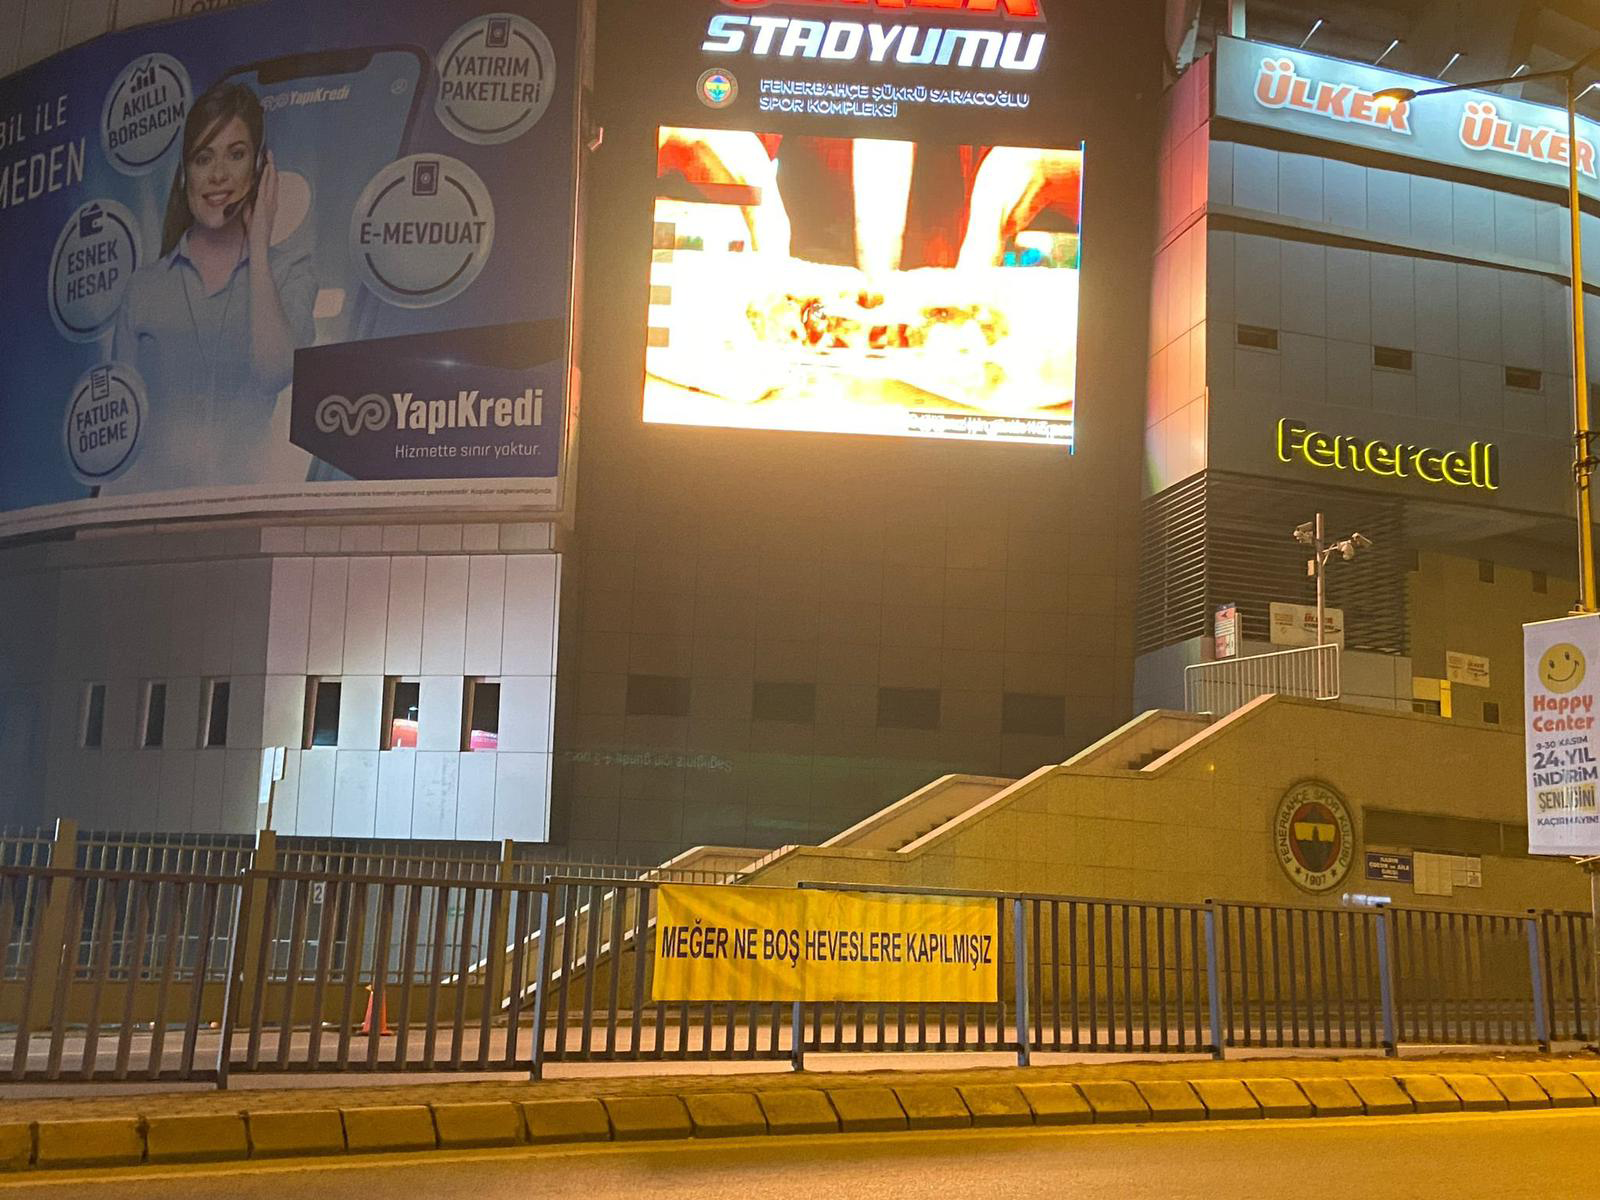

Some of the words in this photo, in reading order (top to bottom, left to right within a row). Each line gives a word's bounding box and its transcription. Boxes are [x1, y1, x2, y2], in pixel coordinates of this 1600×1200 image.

[702, 15, 1046, 71] STADYUMU
[455, 56, 530, 77] YATIRIM
[123, 86, 168, 120] AKILLI
[441, 81, 541, 103] PAKETLERİ
[759, 79, 870, 100] FENERBAHÇE
[1255, 58, 1411, 134] ÜLKER
[759, 97, 805, 113] SPOR
[806, 98, 898, 118] KOMPLEKSİ
[108, 102, 185, 149] BORSACIM
[1461, 102, 1597, 177] ÜLKER
[360, 221, 487, 245] E-MEVDUAT
[67, 238, 119, 275] ESNEK
[66, 267, 119, 303] HESAP
[76, 397, 129, 431] FATURA
[393, 389, 544, 434] YapıKredi
[79, 420, 128, 453] ÖDEME
[394, 444, 457, 459] Hizmette
[460, 445, 492, 457] sınır
[1277, 417, 1500, 490] Fenercell
[1532, 694, 1593, 715] Happy
[1532, 715, 1595, 732] Center
[315, 885, 322, 901] 2
[1304, 874, 1327, 886] 1907
[661, 919, 729, 959] MEĞER
[733, 928, 758, 960] NE
[763, 928, 801, 968] BOŞ
[805, 930, 902, 963] HEVESLERE
[906, 932, 993, 971] KAPILMIŞIZ
